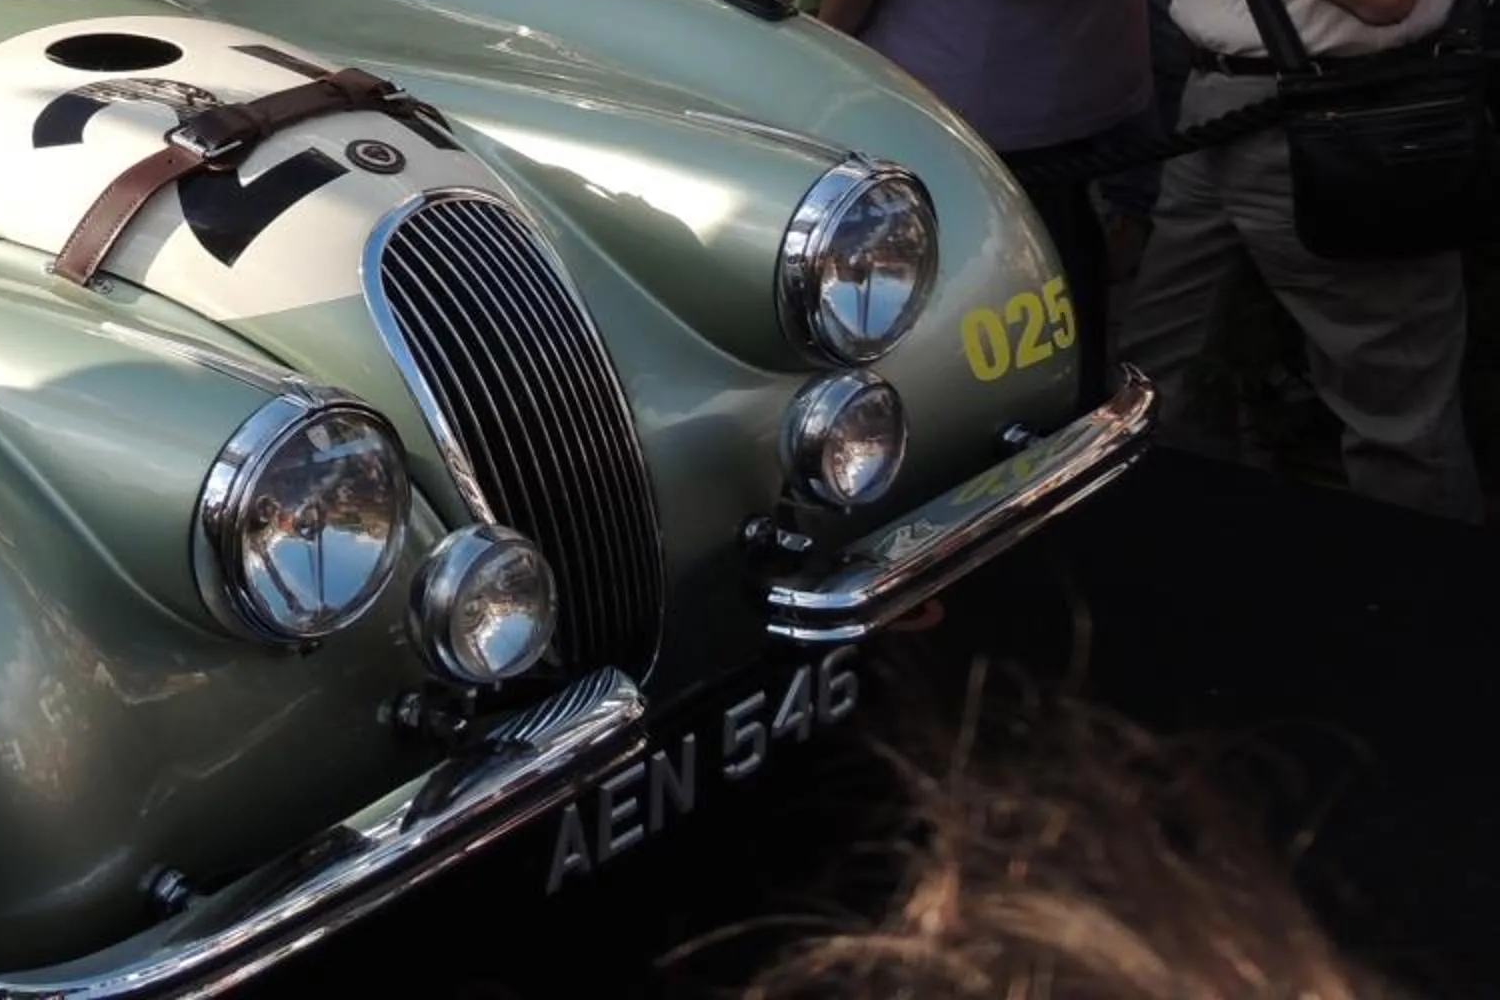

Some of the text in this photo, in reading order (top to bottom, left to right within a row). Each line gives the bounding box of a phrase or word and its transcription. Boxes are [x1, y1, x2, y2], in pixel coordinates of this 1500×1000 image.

[962, 277, 1076, 381] 025
[546, 644, 859, 896] AEN 546
